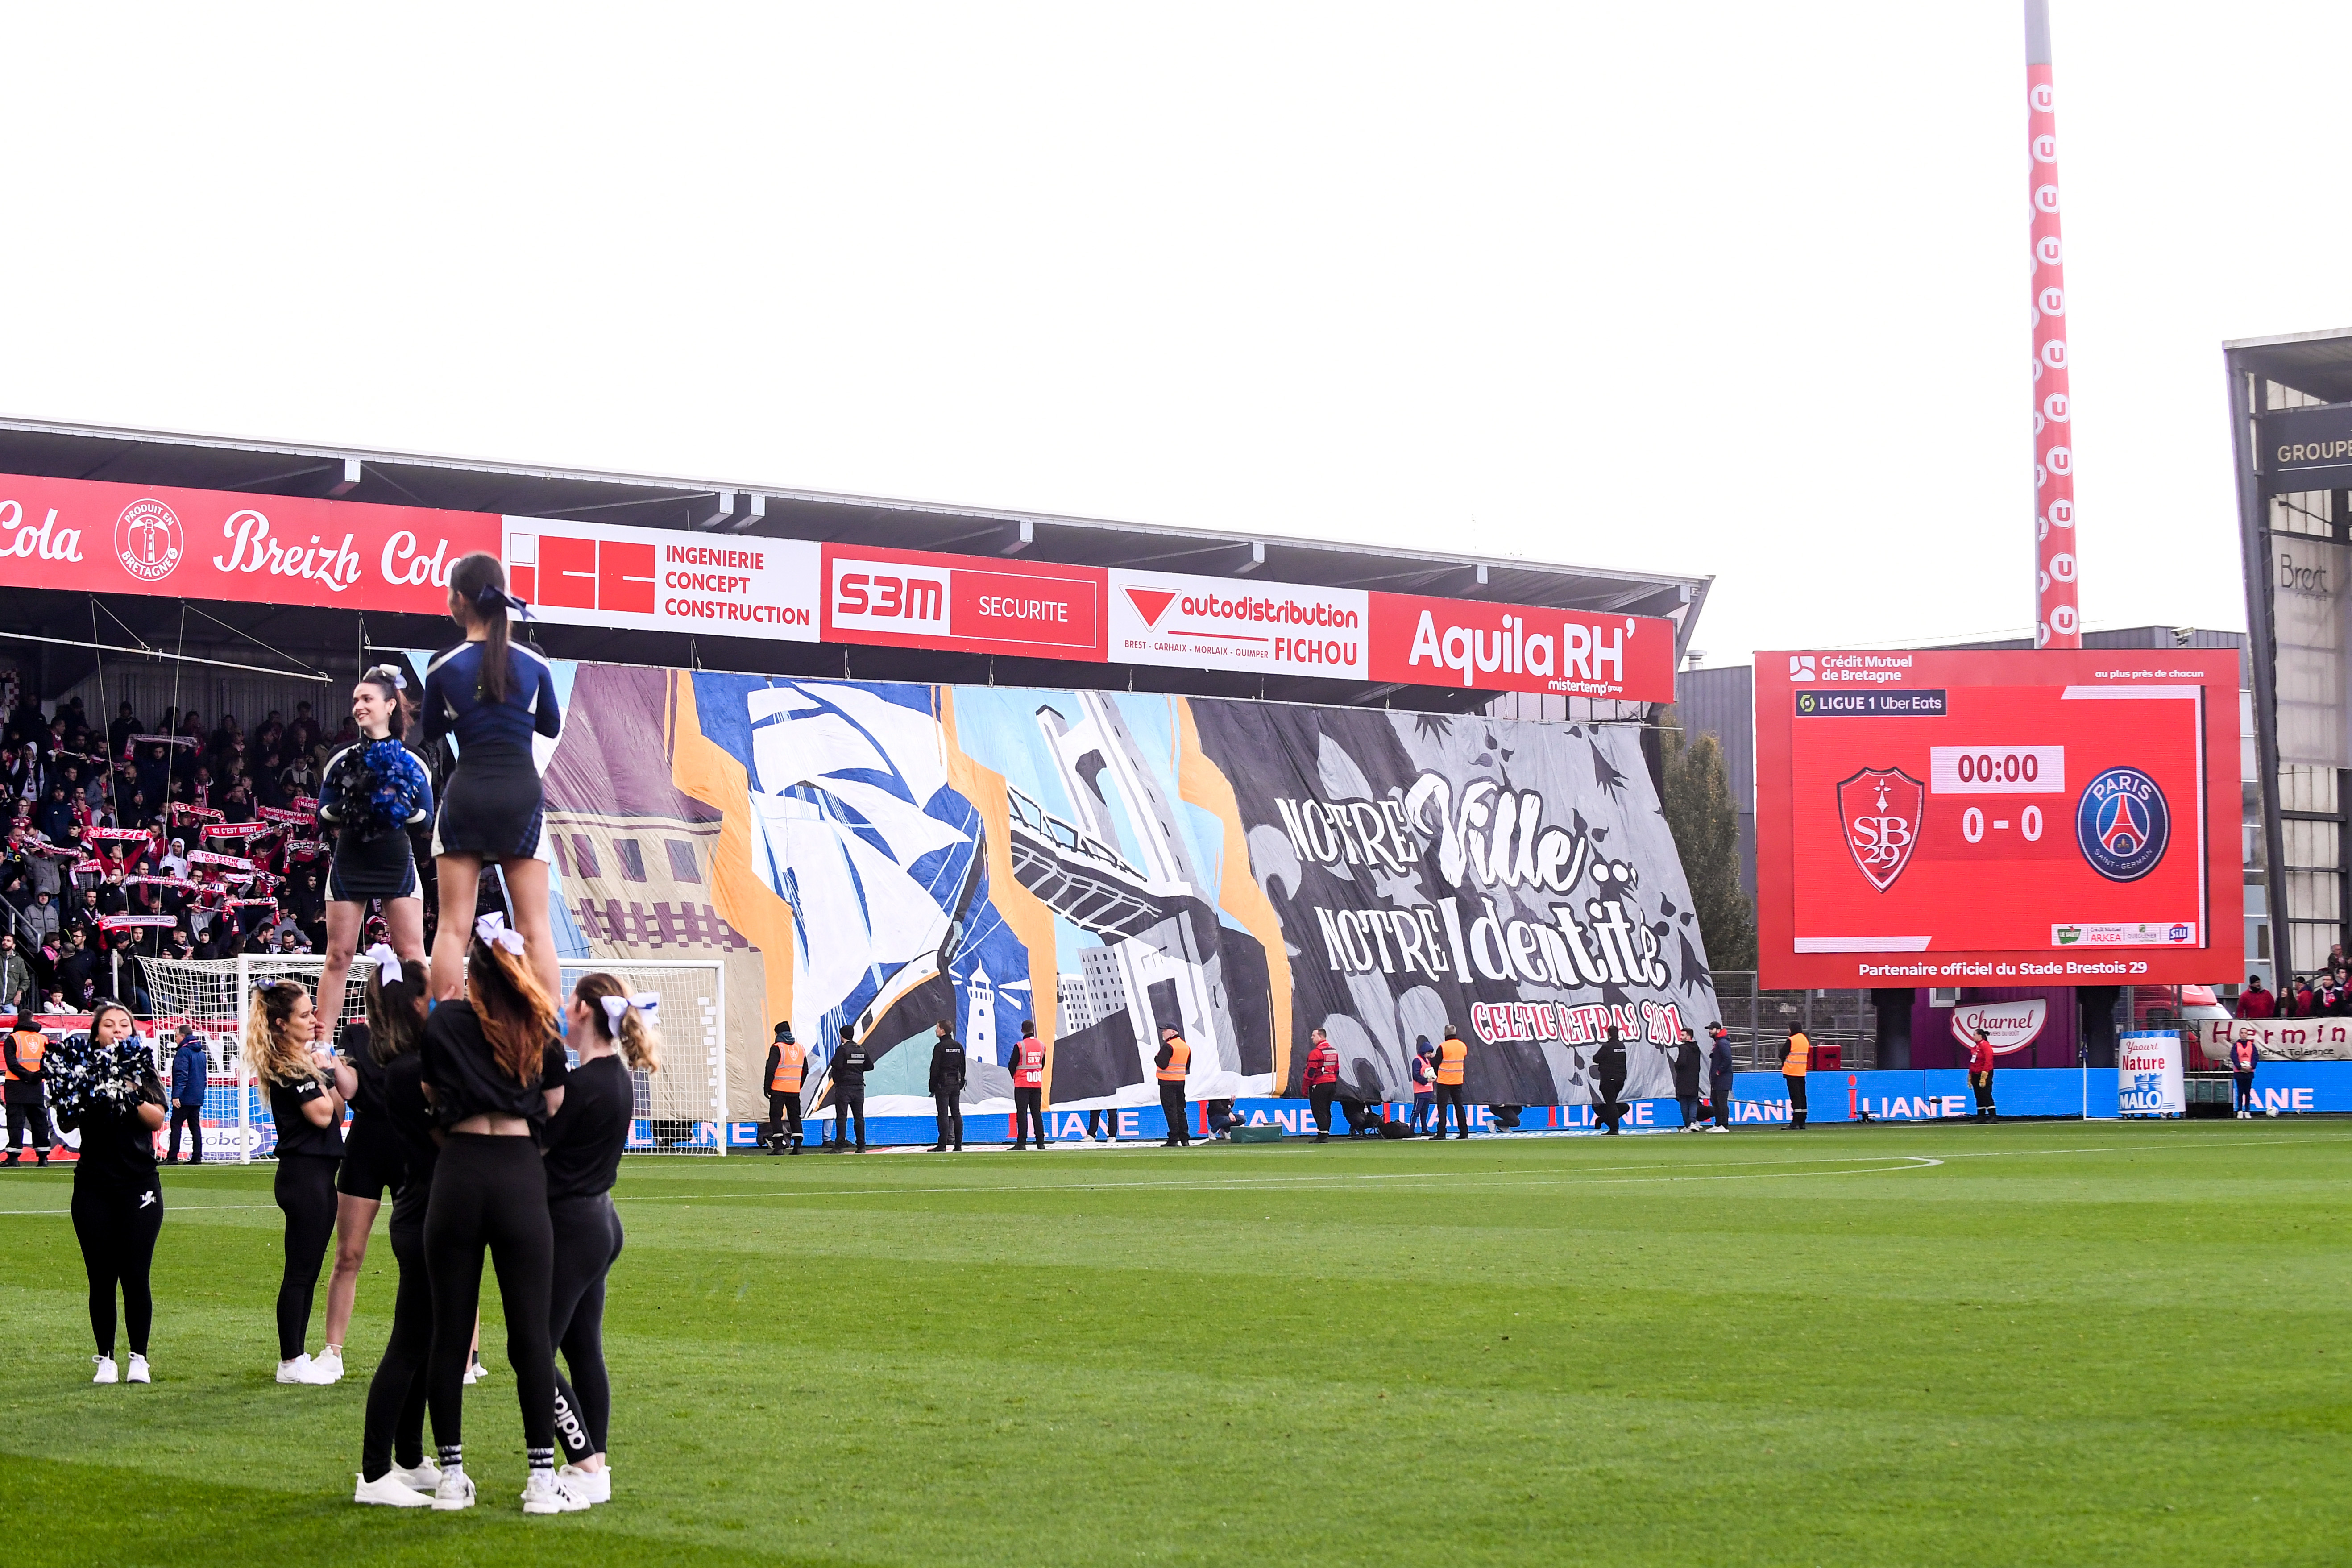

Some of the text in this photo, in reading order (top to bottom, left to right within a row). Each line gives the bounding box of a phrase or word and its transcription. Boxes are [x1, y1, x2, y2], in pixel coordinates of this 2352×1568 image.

[2038, 91, 2051, 106] U
[2040, 142, 2053, 157] U
[2042, 192, 2056, 207] U
[2045, 244, 2058, 258] U
[2047, 295, 2060, 310] U
[2050, 348, 2063, 362] U
[2052, 402, 2066, 416] U
[2054, 454, 2068, 469] U
[124, 504, 174, 526] PRODUIT EN
[2057, 507, 2070, 521] U
[0, 500, 83, 562] Cola
[213, 510, 361, 592] Breizh
[666, 545, 764, 570] INGENIERIE
[121, 550, 173, 577] BRETAGNE
[2058, 561, 2071, 576] U
[665, 572, 750, 594] CONCEPT
[838, 573, 942, 620] S3M
[665, 598, 809, 626] CONSTRUCTION
[979, 596, 1068, 622] SECURITE
[1181, 593, 1358, 629] autodistribution
[2059, 613, 2072, 628] U
[1125, 640, 1146, 650] BREST
[1156, 643, 1187, 652] CARHAIX
[1195, 645, 1228, 655] MORLAIX
[1236, 648, 1269, 659] QUIMPER
[1275, 637, 1357, 665] FICHOU
[1409, 610, 1554, 686] Aquila
[1821, 655, 1912, 668] Crédit Mutuel
[1822, 669, 1902, 683] de Bretagne
[2110, 669, 2131, 679] plus
[2132, 669, 2153, 679] près
[2155, 669, 2167, 677] de
[2169, 669, 2204, 677] chacun
[1820, 696, 1942, 710] LIGUE 1 Uber Eats
[1958, 754, 2038, 783] 00:00
[2092, 775, 2152, 801] PARIS
[1853, 816, 1911, 847] SB
[1962, 807, 1984, 843] 0
[2021, 805, 2043, 842] 0
[1274, 798, 1419, 873] NOTRE
[1863, 845, 1900, 869] 29
[1314, 897, 1667, 987] NOTRE Identité
[2170, 929, 2186, 938] Sill
[1859, 961, 2148, 976] Partenaire officiel du Stade Brestois 29
[1472, 1002, 1558, 1045] CELTIC
[1967, 1009, 2034, 1029] Charnel
[2126, 1041, 2159, 1054] Yaourt
[2287, 1048, 2335, 1056] Tolérance
[2123, 1055, 2165, 1070] Nature
[2120, 1091, 2162, 1109] MALO
